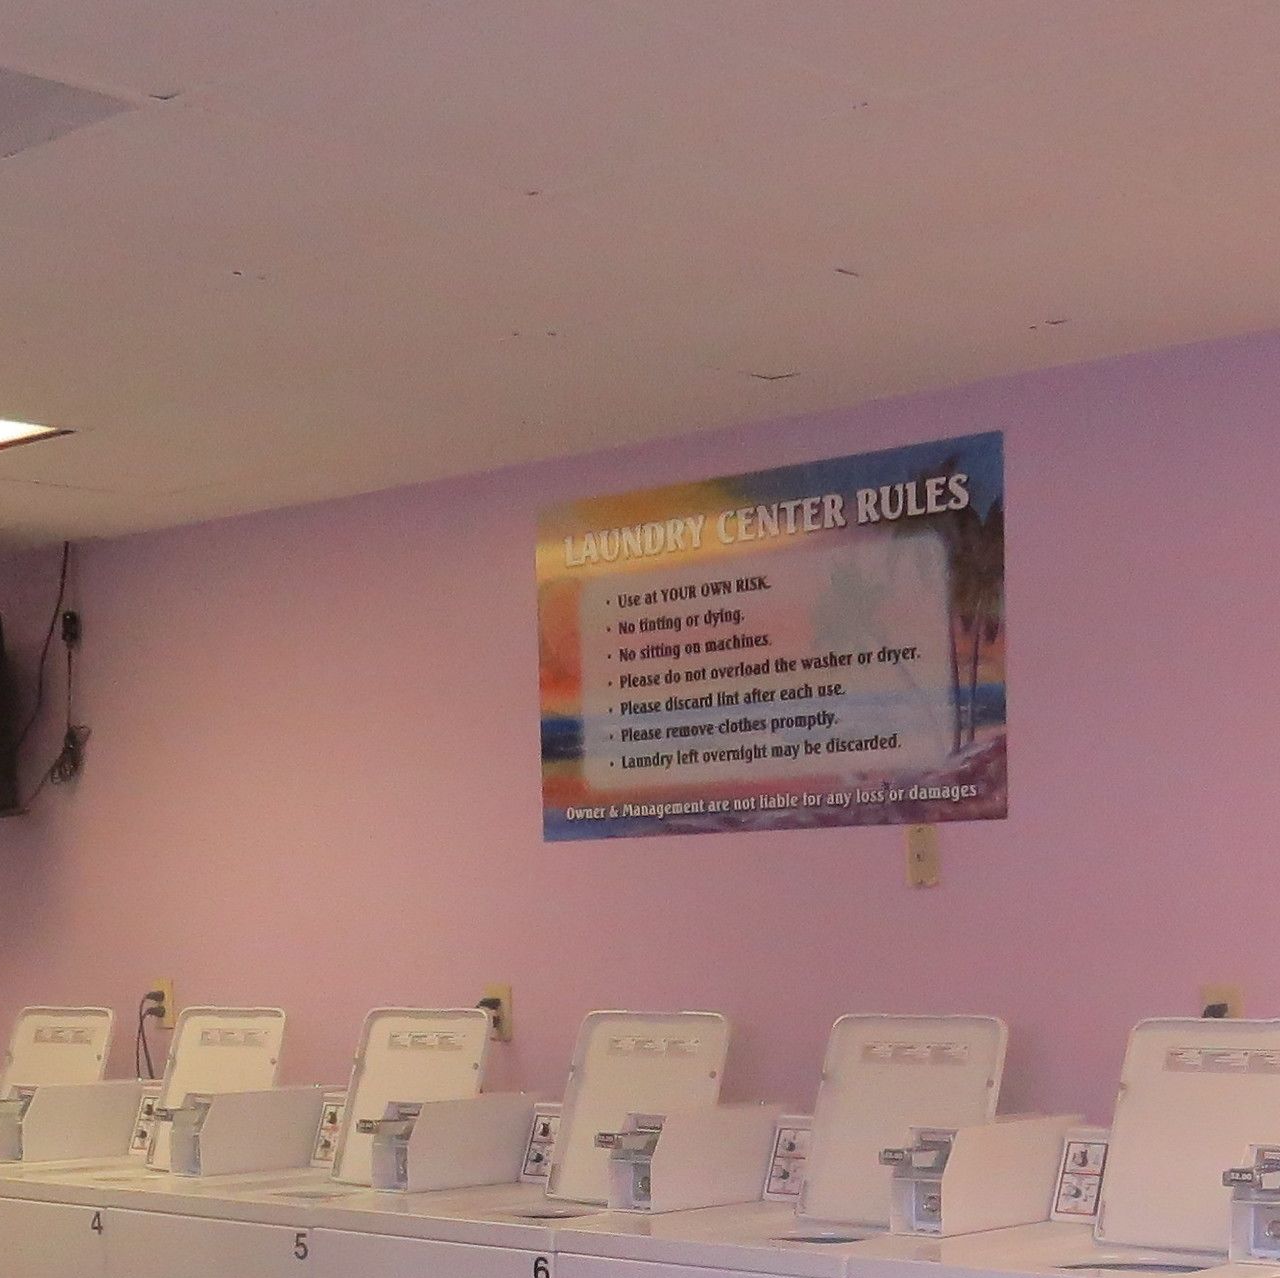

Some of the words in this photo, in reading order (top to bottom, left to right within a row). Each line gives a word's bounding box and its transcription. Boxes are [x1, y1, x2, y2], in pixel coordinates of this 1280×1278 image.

[564, 515, 705, 568] LAUNDRY
[717, 494, 847, 544] CENTER
[857, 474, 970, 523] RULES
[618, 595, 641, 608] Use
[645, 591, 657, 605] at
[660, 585, 696, 601] YOUR
[701, 581, 732, 596] OWN
[736, 576, 771, 592] RISK.
[619, 622, 635, 635] No
[640, 617, 681, 633] tinting
[686, 615, 700, 627] or
[704, 609, 744, 626] dying.
[620, 649, 636, 662] No
[640, 643, 680, 659] sitting
[685, 642, 700, 653] on
[705, 633, 772, 652] machines.
[620, 674, 660, 688] Please
[664, 670, 680, 684] do
[685, 669, 706, 682] not
[711, 660, 769, 678] overload
[774, 658, 796, 673] the
[801, 651, 852, 669] washer
[858, 650, 873, 664] or
[877, 647, 920, 665] dryer.
[620, 701, 661, 715] Please
[665, 694, 712, 709] discard
[717, 692, 739, 706] lint
[743, 688, 775, 704] after
[780, 684, 812, 701] each
[817, 683, 845, 696] use.
[621, 728, 661, 742] Please
[667, 724, 713, 738] remove
[718, 716, 766, 734] clothes
[771, 710, 837, 733] promptly.
[622, 752, 672, 770] Laundry
[677, 750, 699, 765] left
[703, 743, 767, 763] overnight
[771, 744, 800, 760] may
[804, 740, 820, 755] be
[826, 733, 901, 753] discarded.
[566, 806, 605, 820] Owner
[609, 806, 620, 817] &
[623, 799, 704, 818] Management
[708, 800, 729, 811] are
[734, 796, 755, 810] not
[760, 794, 798, 809] liable
[803, 792, 821, 806] for
[826, 792, 852, 807] any
[856, 789, 885, 804] loss
[889, 788, 903, 800] or
[909, 783, 977, 802] damages
[91, 1211, 104, 1235] 4
[294, 1233, 308, 1260] 5
